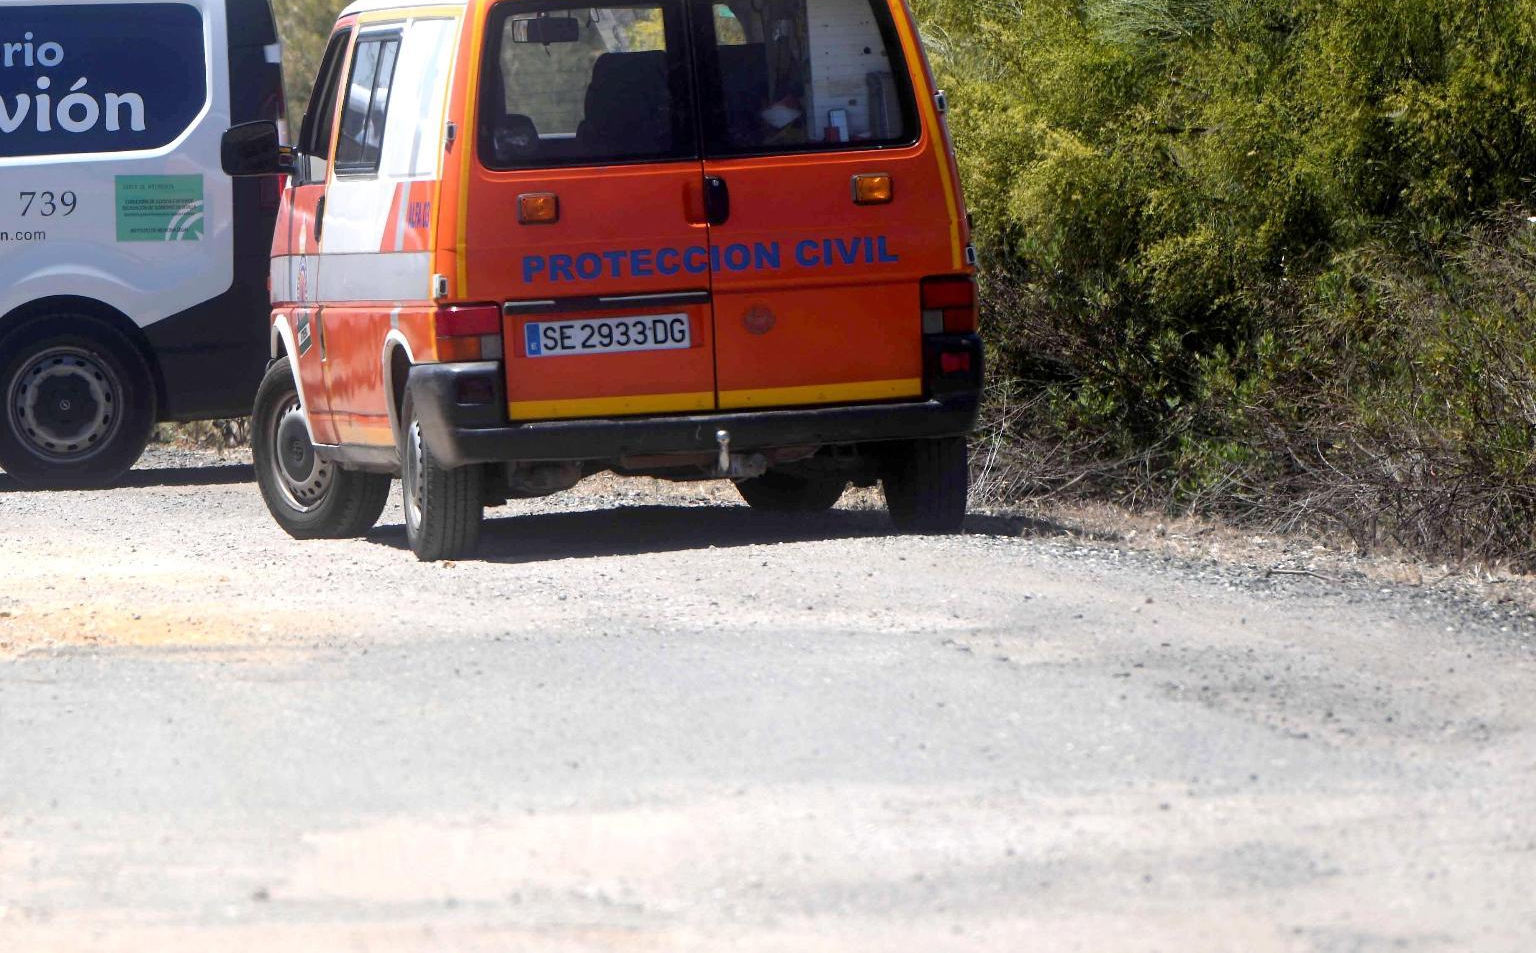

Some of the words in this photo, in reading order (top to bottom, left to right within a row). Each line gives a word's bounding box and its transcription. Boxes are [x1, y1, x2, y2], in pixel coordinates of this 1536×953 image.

[19, 190, 78, 216] 739
[521, 242, 782, 284] PROTECCION
[794, 235, 899, 268] CIVIL
